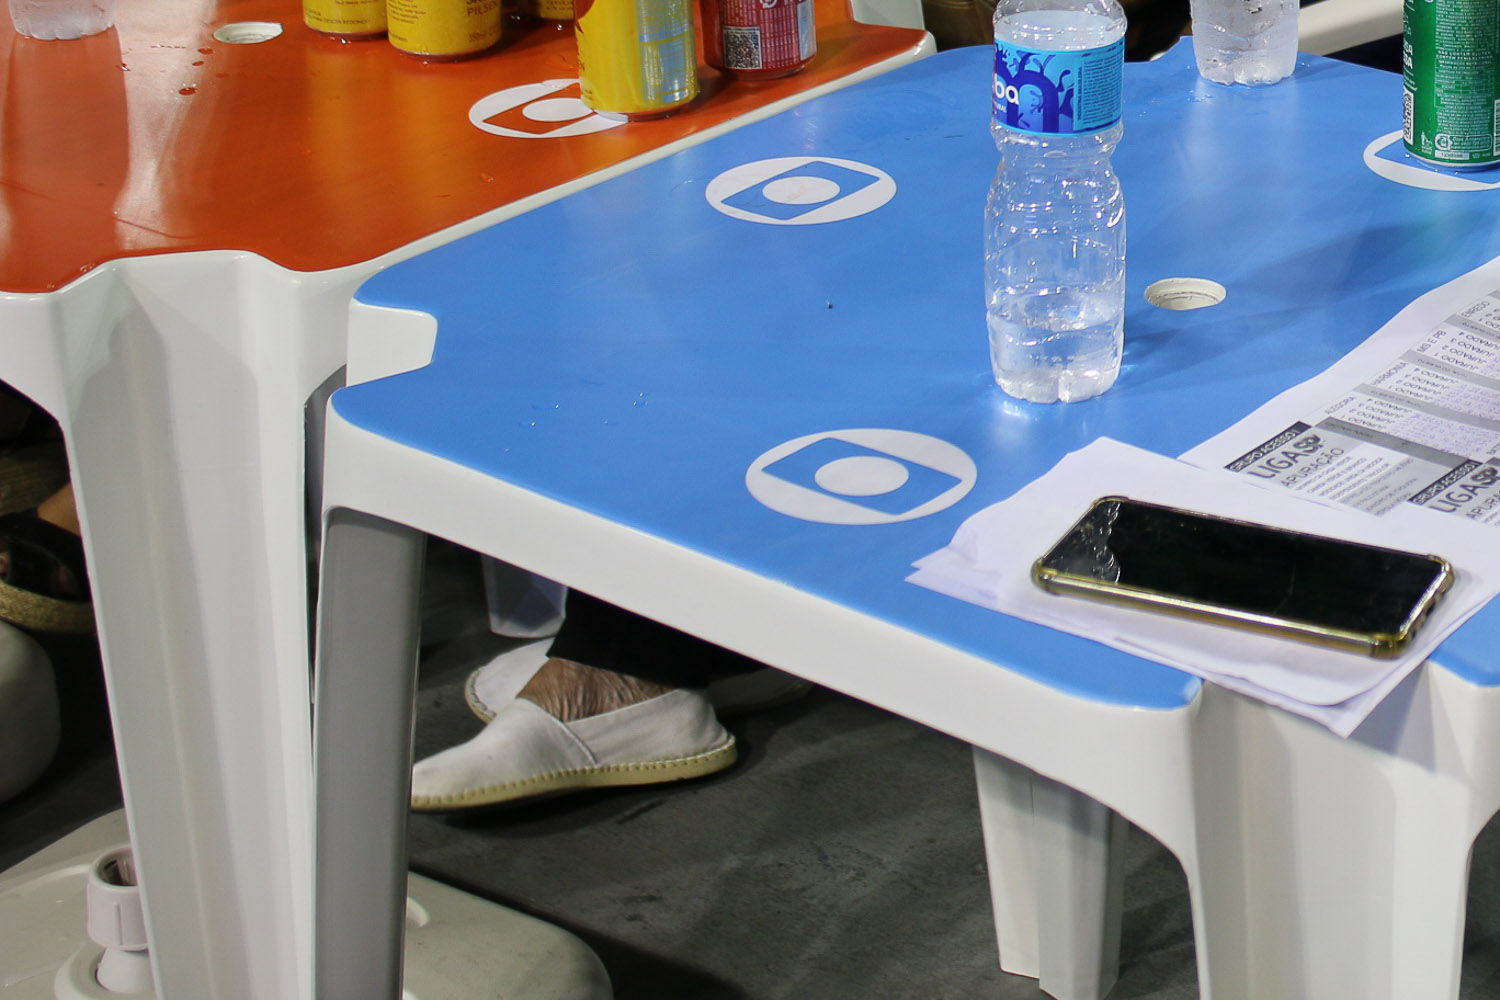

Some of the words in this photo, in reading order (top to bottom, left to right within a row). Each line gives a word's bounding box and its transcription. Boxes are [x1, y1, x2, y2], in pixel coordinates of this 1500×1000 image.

[467, 1, 498, 16] PILSEN
[1461, 300, 1490, 318] ENREDO
[1435, 330, 1447, 340] PB
[1450, 348, 1487, 364] JURADO
[1458, 340, 1495, 358] JURADO
[1442, 355, 1479, 371] JURADO
[1280, 447, 1345, 489] APURAÇÃO
